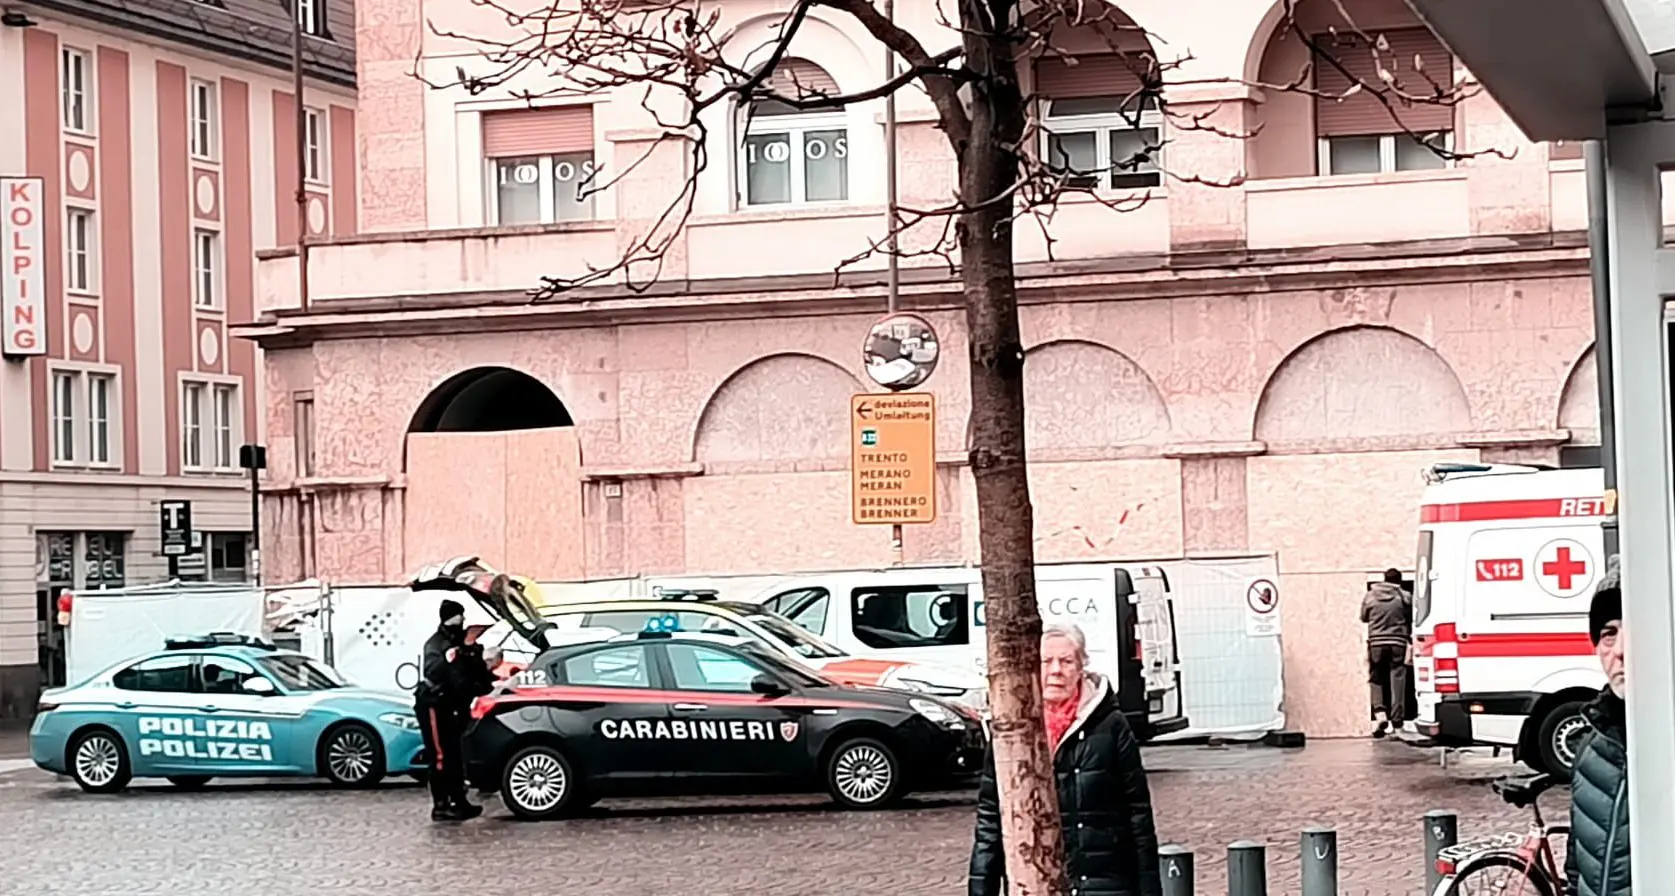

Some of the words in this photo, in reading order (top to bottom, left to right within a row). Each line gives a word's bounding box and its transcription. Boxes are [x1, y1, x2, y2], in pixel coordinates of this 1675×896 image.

[10, 183, 35, 349] KOLPING
[874, 400, 930, 408] deviazione
[874, 411, 930, 421] Umleitung
[861, 453, 908, 463] TRENTO
[860, 469, 911, 479] MERANO
[860, 481, 902, 491] MERAN
[860, 497, 927, 507] BRENNERO
[163, 503, 185, 529] T
[861, 509, 918, 519] BRENNER
[1492, 562, 1521, 577] 112
[516, 670, 546, 684] 112
[138, 717, 272, 740] POLIZIA
[600, 720, 776, 741] CARABINIERI
[139, 738, 273, 761] POLIZEI
